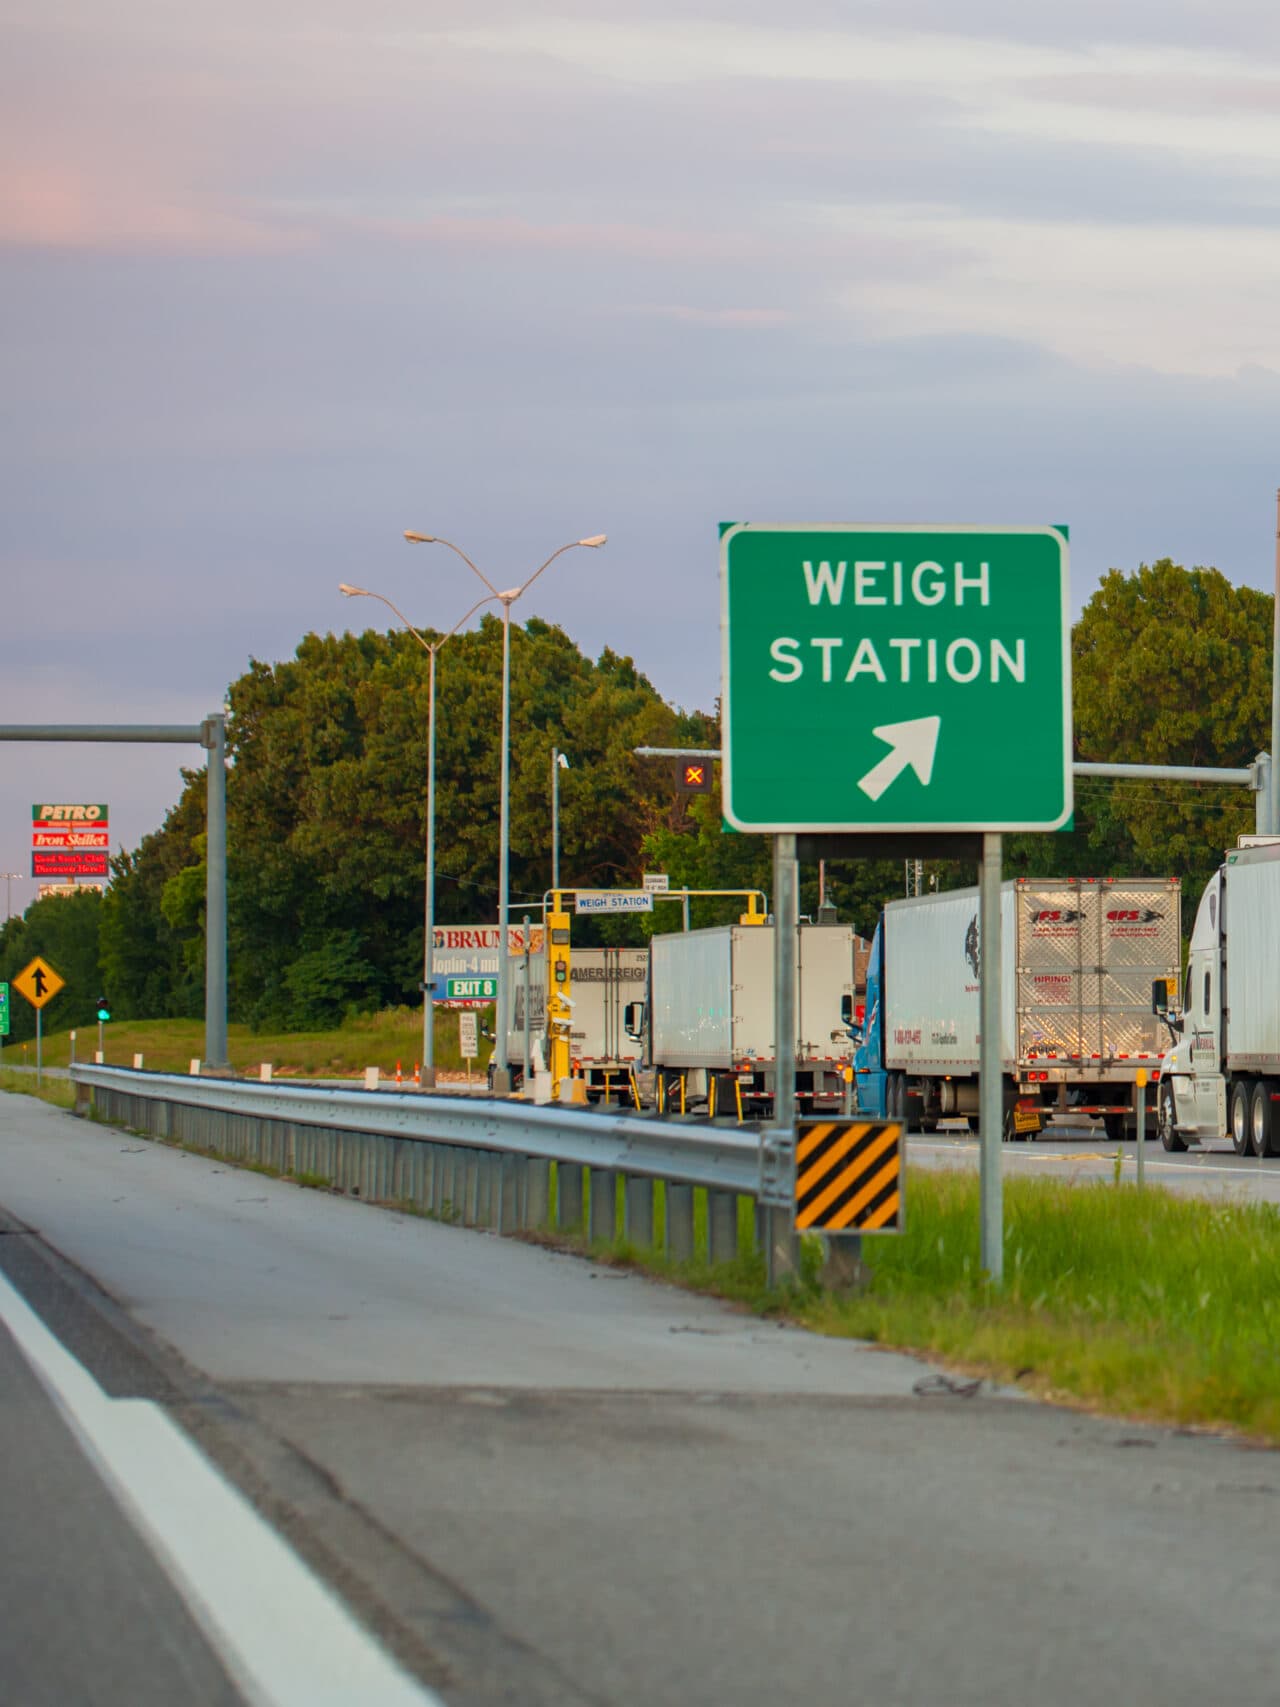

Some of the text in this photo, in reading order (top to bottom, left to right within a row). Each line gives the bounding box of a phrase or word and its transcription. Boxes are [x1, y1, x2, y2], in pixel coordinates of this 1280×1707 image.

[803, 560, 990, 606] WEIGH
[768, 637, 1026, 684] STATION
[40, 805, 101, 820] PETRO
[36, 833, 105, 846] Iron Skillet
[580, 896, 649, 908] WEIGH STATION
[453, 981, 493, 996] EXIT 8
